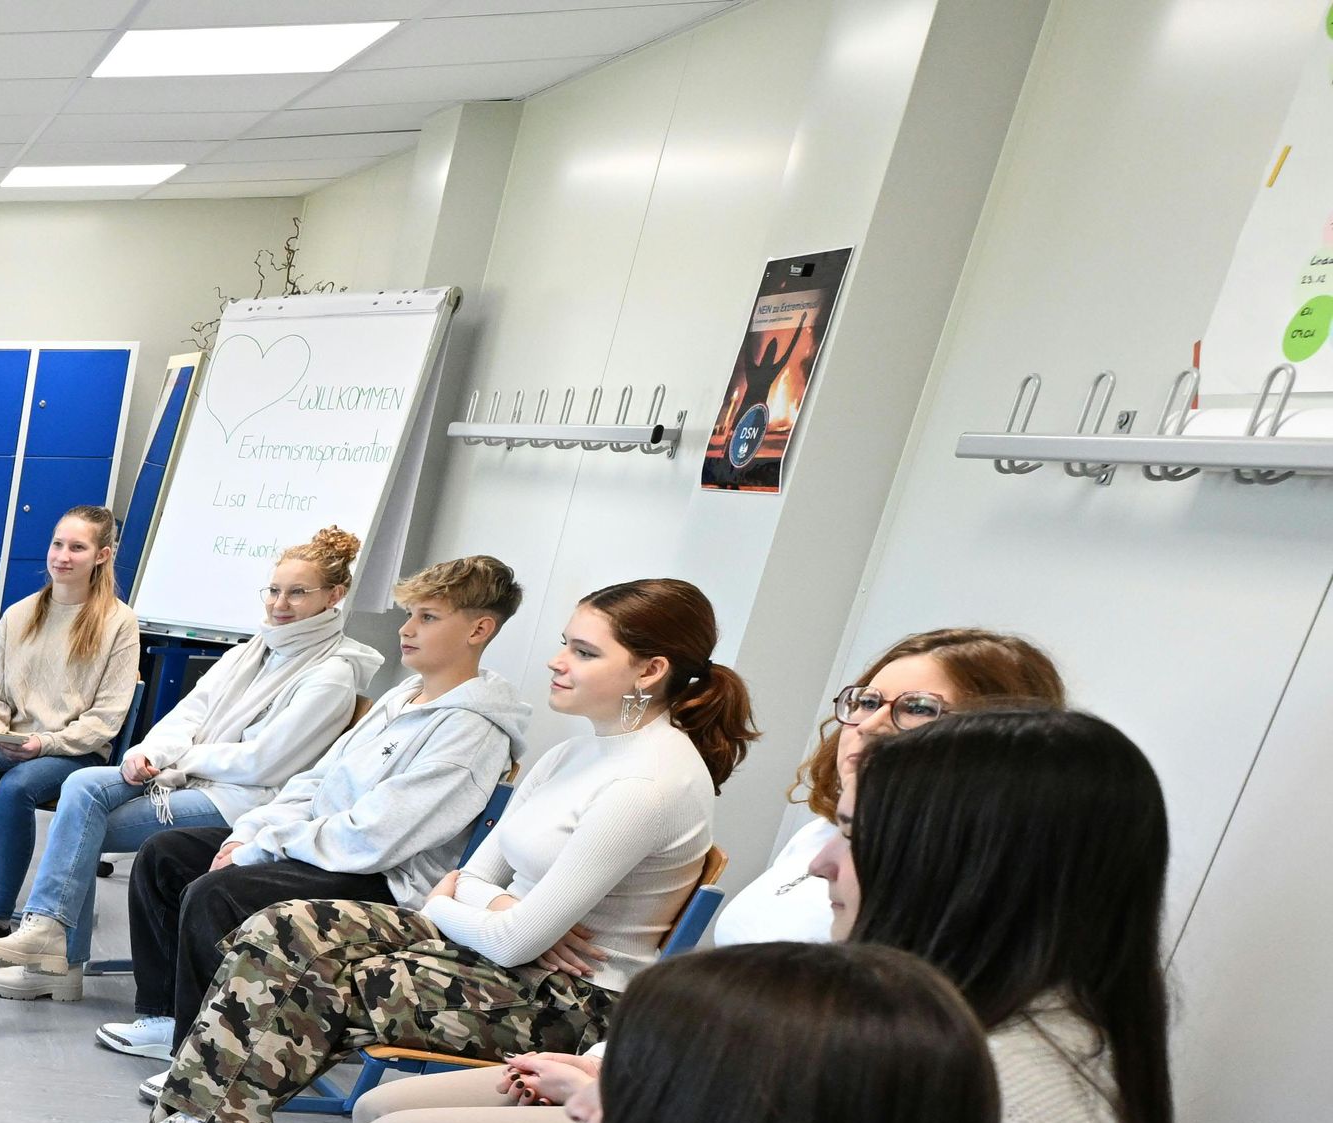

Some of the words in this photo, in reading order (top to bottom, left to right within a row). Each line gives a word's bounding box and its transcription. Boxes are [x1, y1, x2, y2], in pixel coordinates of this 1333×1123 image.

[739, 426, 759, 440] DSN
[238, 428, 393, 473] Extremismusprävention
[213, 480, 246, 508] Lisa
[256, 480, 318, 512] Lechner
